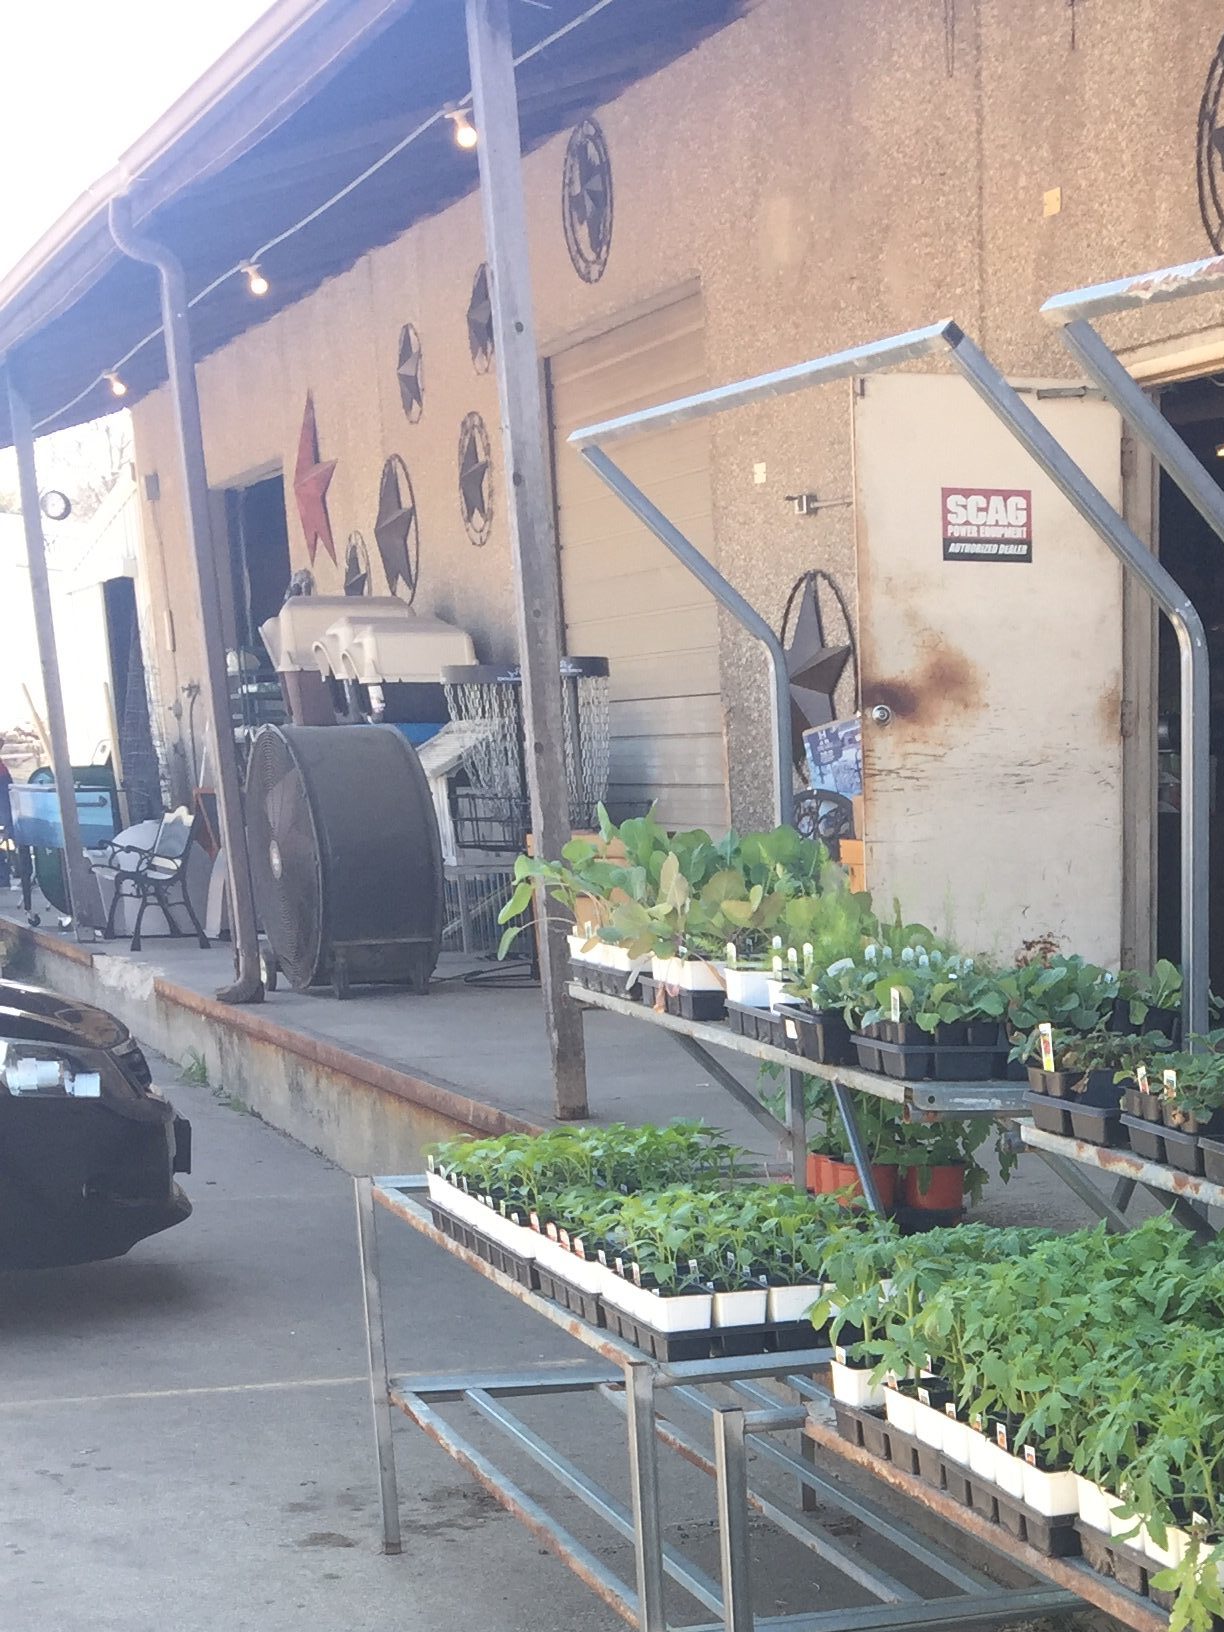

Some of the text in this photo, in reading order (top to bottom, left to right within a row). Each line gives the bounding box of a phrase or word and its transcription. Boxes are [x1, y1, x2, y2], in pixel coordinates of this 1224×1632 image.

[946, 494, 1027, 526] SCAG
[947, 525, 1027, 539] POWER EQUIPMENT
[948, 543, 1028, 555] AUTHORIZED DEALER
